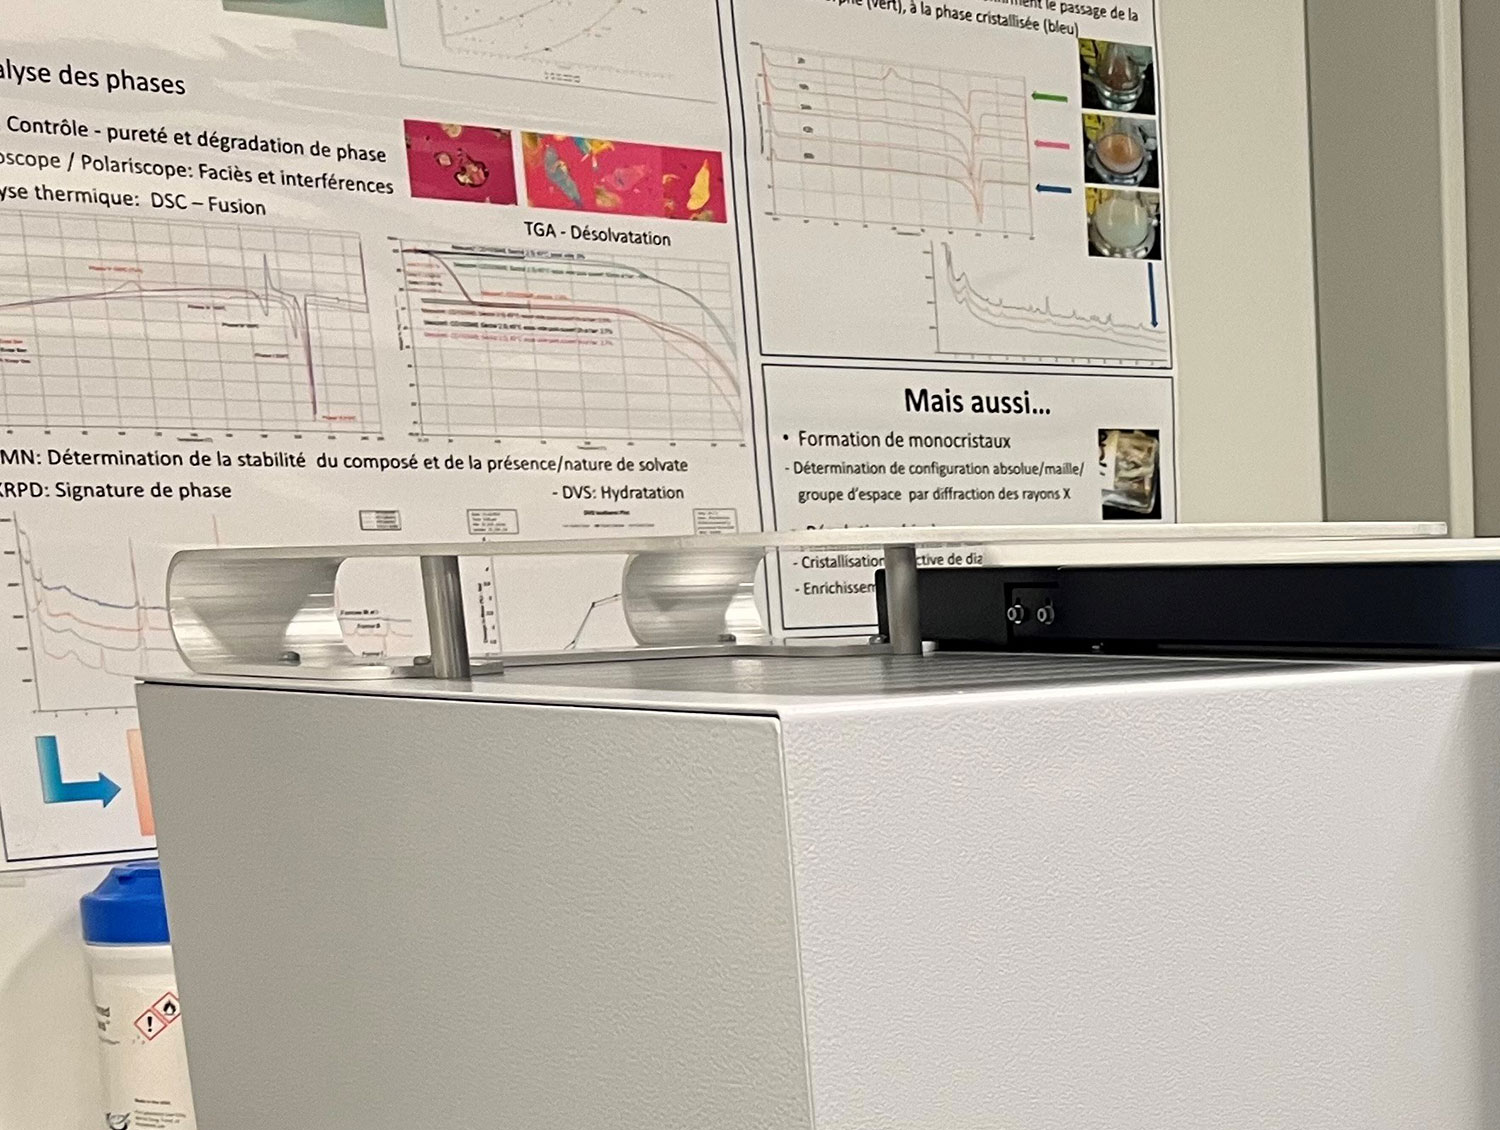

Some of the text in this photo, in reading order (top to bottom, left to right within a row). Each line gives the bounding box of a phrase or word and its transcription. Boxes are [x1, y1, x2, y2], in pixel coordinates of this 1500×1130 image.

[920, 1, 932, 16] la
[936, 6, 972, 22] phase
[976, 10, 1040, 32] cristallisée
[1044, 19, 1079, 38] (bleu)
[1060, 2, 1107, 20] passage
[1110, 6, 1126, 20] de
[1128, 8, 1139, 22] la
[59, 64, 100, 87] des
[106, 69, 186, 96] phases
[7, 115, 90, 138] Contrôle
[107, 122, 168, 144] pureté
[173, 129, 192, 146] et
[197, 129, 304, 157] dégradation
[310, 141, 332, 158] de
[336, 143, 387, 165] phase
[81, 154, 194, 180] Polariscope:
[199, 162, 253, 184] Faciès
[258, 169, 276, 186] et
[280, 169, 394, 196] interférences
[34, 184, 140, 208] thermique:
[150, 192, 188, 212] DSC
[208, 197, 267, 217] Fusion
[524, 220, 556, 238] TGA
[571, 225, 672, 247] Désolvatation
[904, 388, 1052, 415] Mais aussi...
[799, 430, 1011, 450] Formation de monocristaux
[48, 448, 184, 468] Détermination
[190, 450, 212, 468] de
[216, 450, 232, 468] la
[238, 450, 306, 469] stabilité
[316, 452, 338, 470] du
[344, 454, 418, 474] composé
[424, 456, 441, 471] et
[444, 454, 465, 471] de
[468, 454, 482, 471] la
[487, 454, 613, 474] présence/nature
[616, 456, 635, 472] de
[638, 456, 689, 473] solvate
[793, 460, 886, 476] Détermination
[890, 461, 906, 476] de
[908, 461, 990, 479] configuration
[992, 460, 1084, 478] absolue/maille/
[0, 482, 232, 501] RPD: Signature de phase
[562, 486, 597, 500] DVS:
[602, 486, 685, 502] Hydratation
[798, 486, 1072, 504] groupe d'espace par diffraction des rayons X
[948, 553, 962, 566] de
